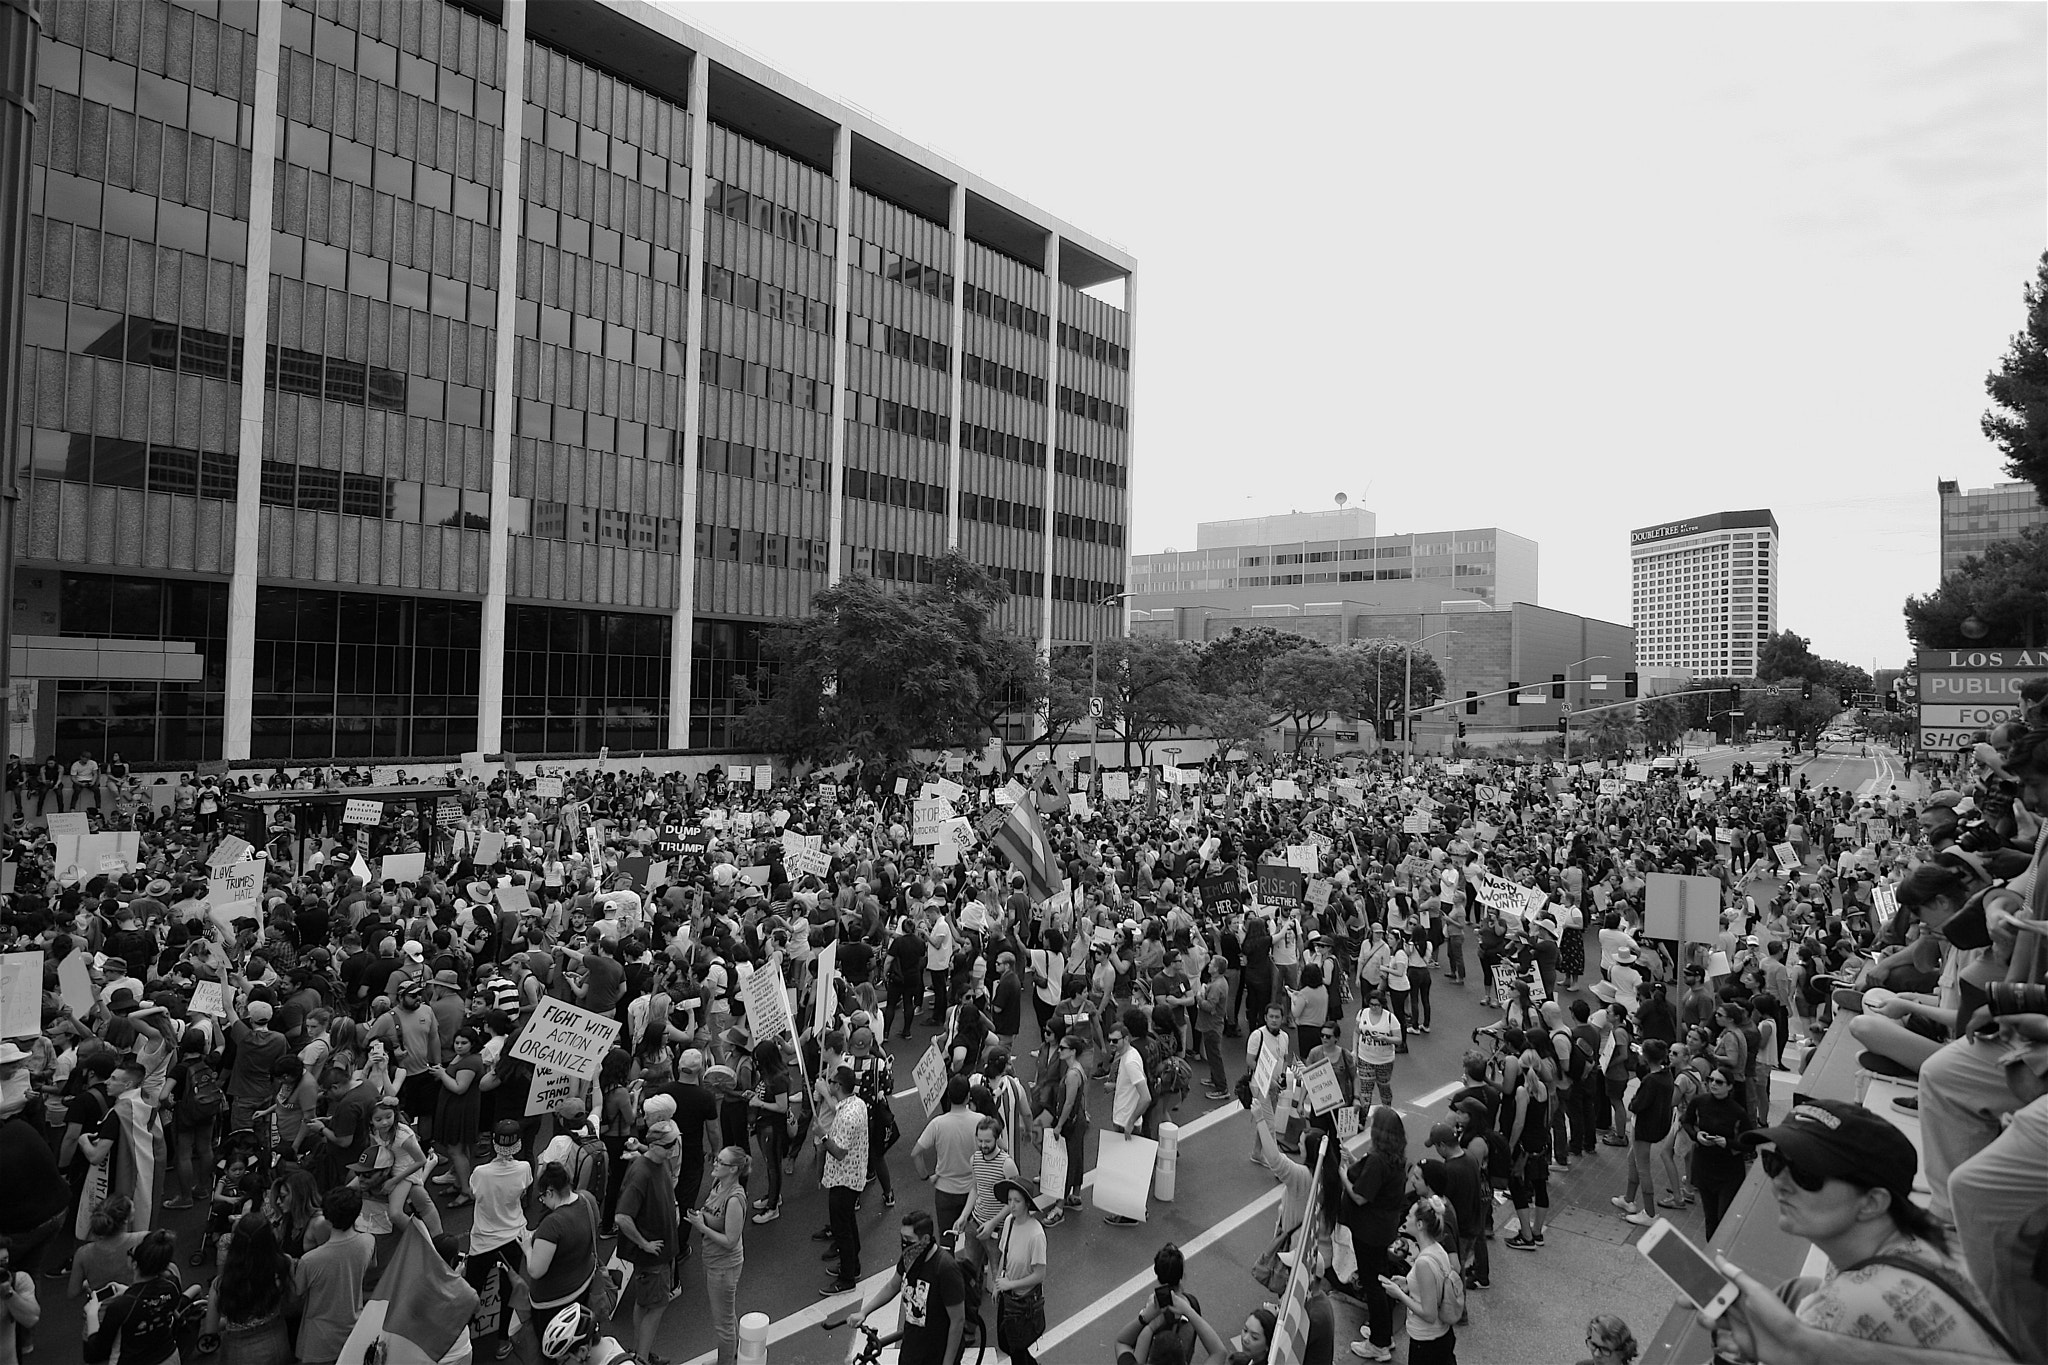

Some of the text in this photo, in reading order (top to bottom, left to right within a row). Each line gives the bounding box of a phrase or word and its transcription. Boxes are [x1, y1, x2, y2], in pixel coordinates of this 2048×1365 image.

[1948, 651, 2003, 667] LOS
[1932, 678, 2024, 694] PUBLIC
[914, 807, 940, 822] STOP
[666, 825, 701, 836] DUMP
[659, 842, 704, 853] TRUMP!
[214, 865, 237, 880] LOVE
[226, 875, 254, 890] TRUMPS
[1220, 881, 1236, 894] WITH
[1260, 876, 1287, 895] RISE
[1483, 877, 1517, 894] Nasty
[235, 888, 254, 900] HATE
[1262, 895, 1298, 907] TOGETHER
[1480, 890, 1523, 901] Women
[1215, 900, 1233, 914] HER
[1496, 899, 1526, 908] UNITE
[543, 1006, 613, 1040] FIGHT WITH
[546, 1028, 592, 1051] ACTION
[520, 1039, 592, 1073] ORGANIZE
[916, 1047, 937, 1079] NEVER
[537, 1067, 553, 1077] We
[926, 1066, 936, 1086] MY
[547, 1076, 569, 1086] with
[536, 1087, 570, 1103] STAND
